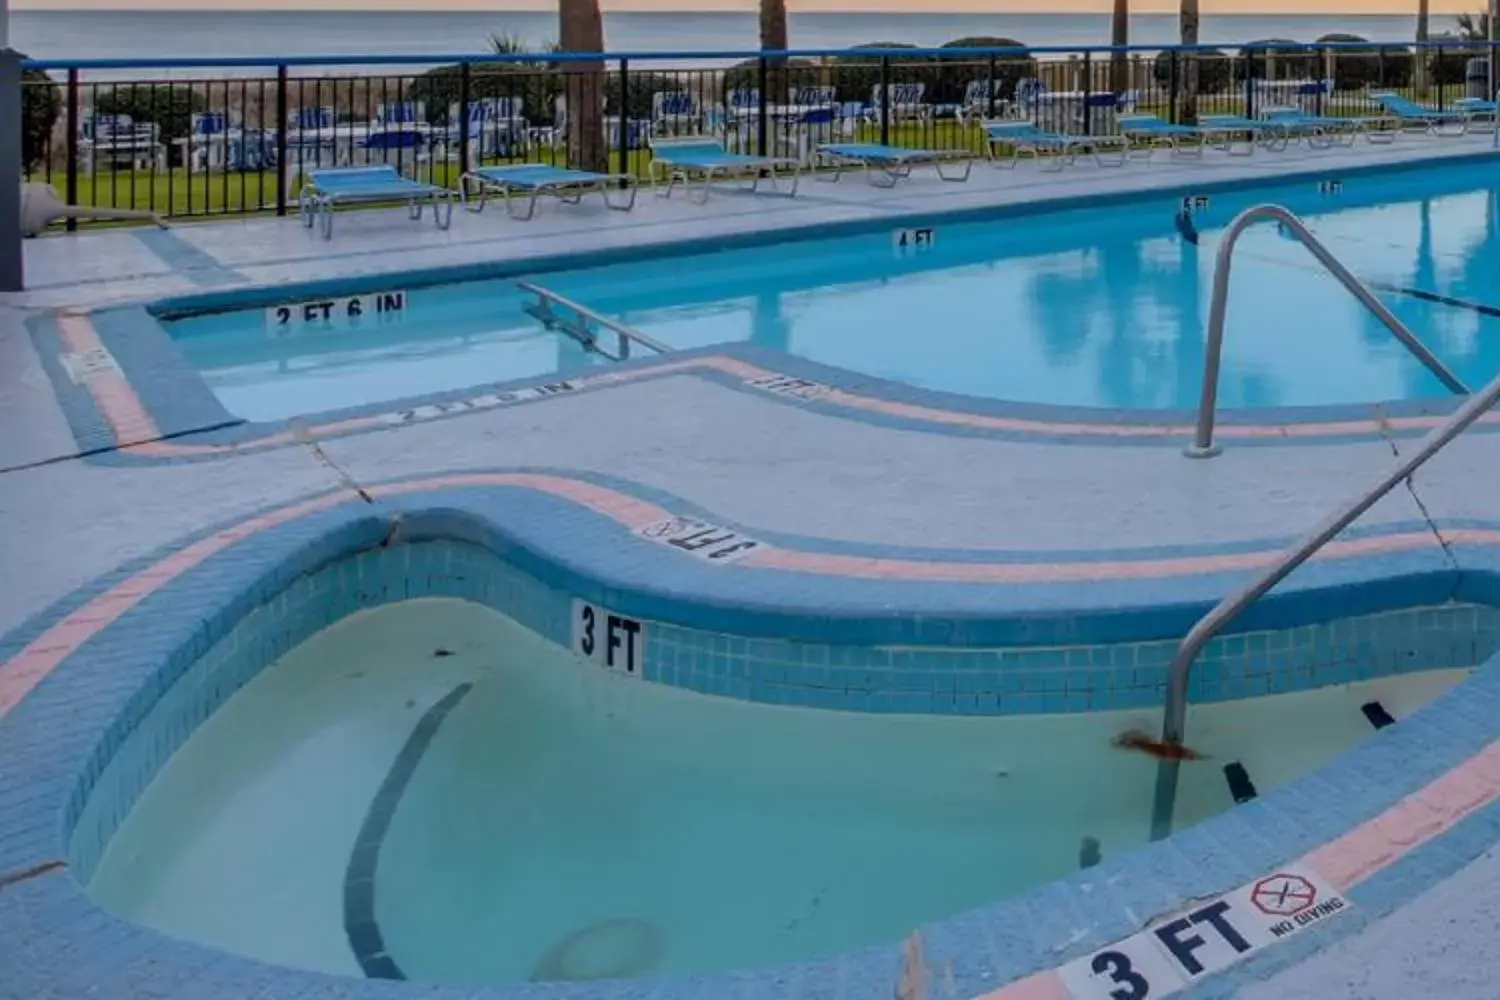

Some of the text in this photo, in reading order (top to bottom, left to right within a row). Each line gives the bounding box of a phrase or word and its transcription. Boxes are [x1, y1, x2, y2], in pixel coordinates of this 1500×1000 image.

[304, 302, 335, 321] FT
[377, 293, 403, 313] IN
[582, 605, 641, 672] 3 FT
[1091, 897, 1344, 1000] 3 FT NO DIVING
